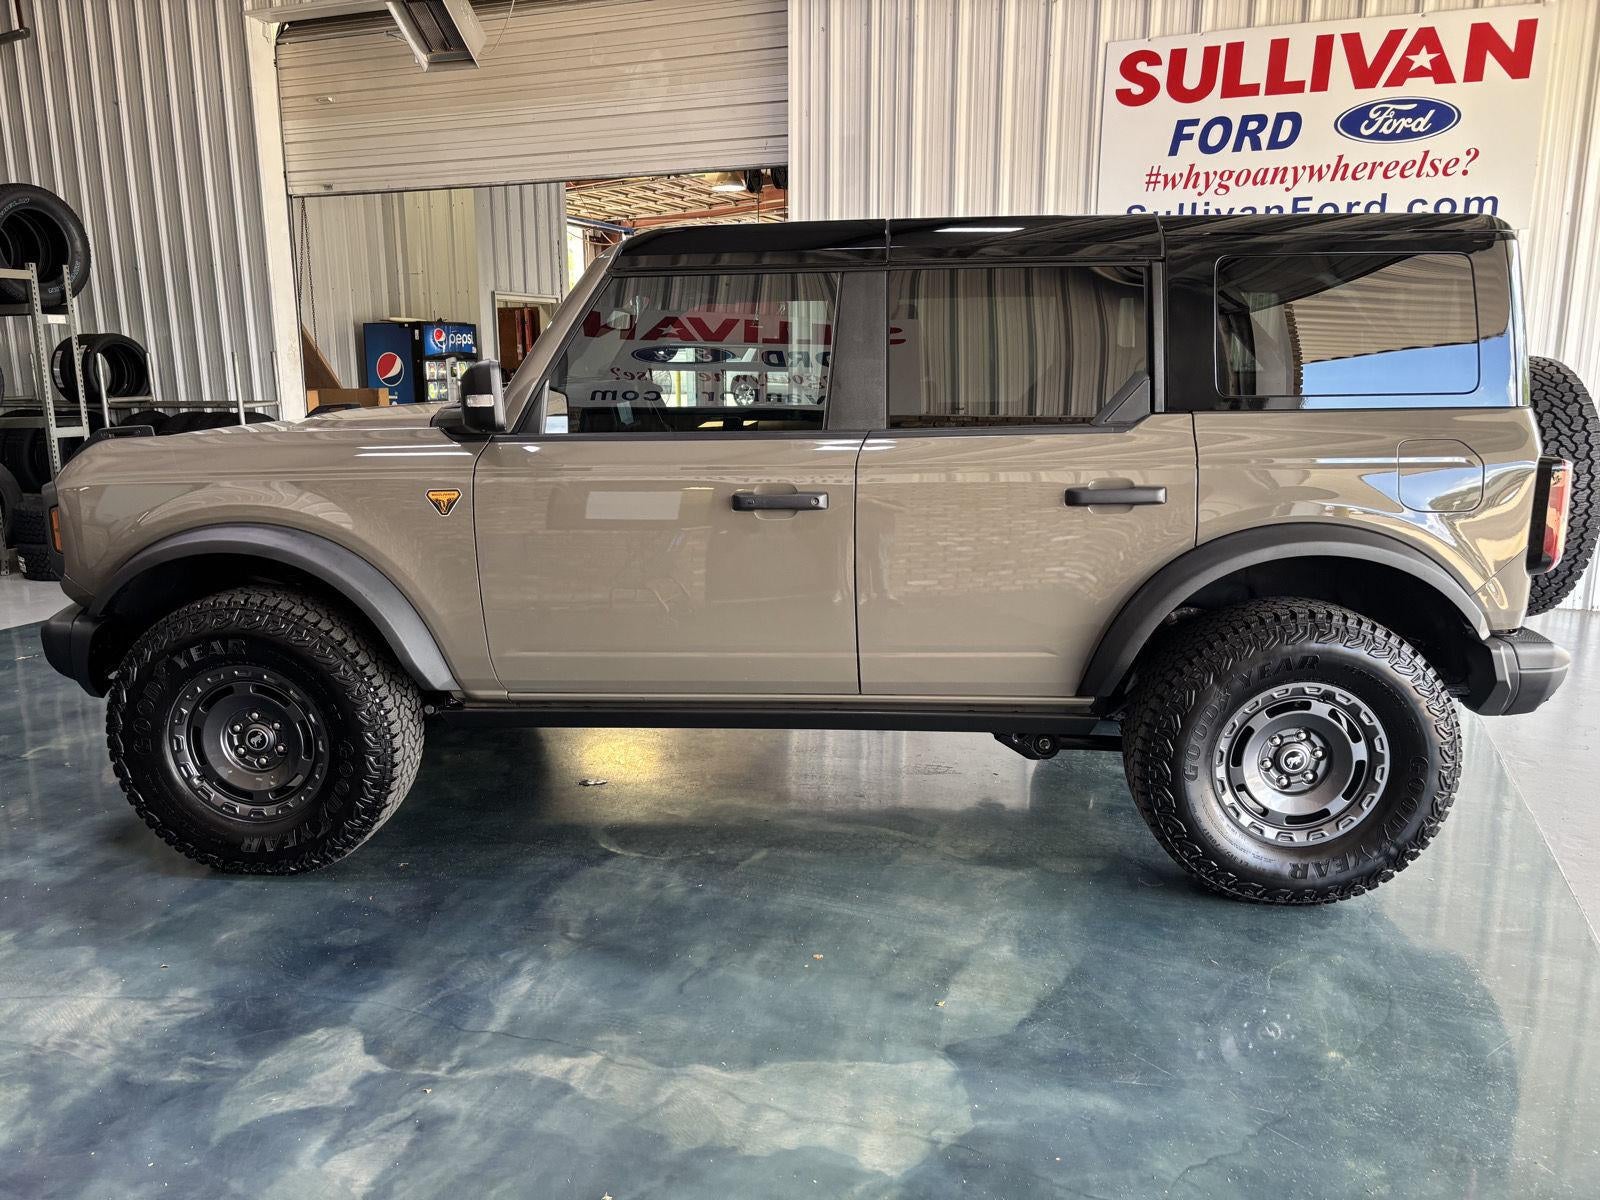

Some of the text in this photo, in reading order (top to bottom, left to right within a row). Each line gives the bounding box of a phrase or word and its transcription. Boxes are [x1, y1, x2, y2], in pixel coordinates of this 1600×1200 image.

[1115, 18, 1538, 107] SULLIVAN
[1168, 111, 1302, 157] FORD
[1360, 103, 1435, 136] Ford
[1145, 147, 1479, 197] #whygoanywhereelse?
[449, 331, 474, 345] pepsi
